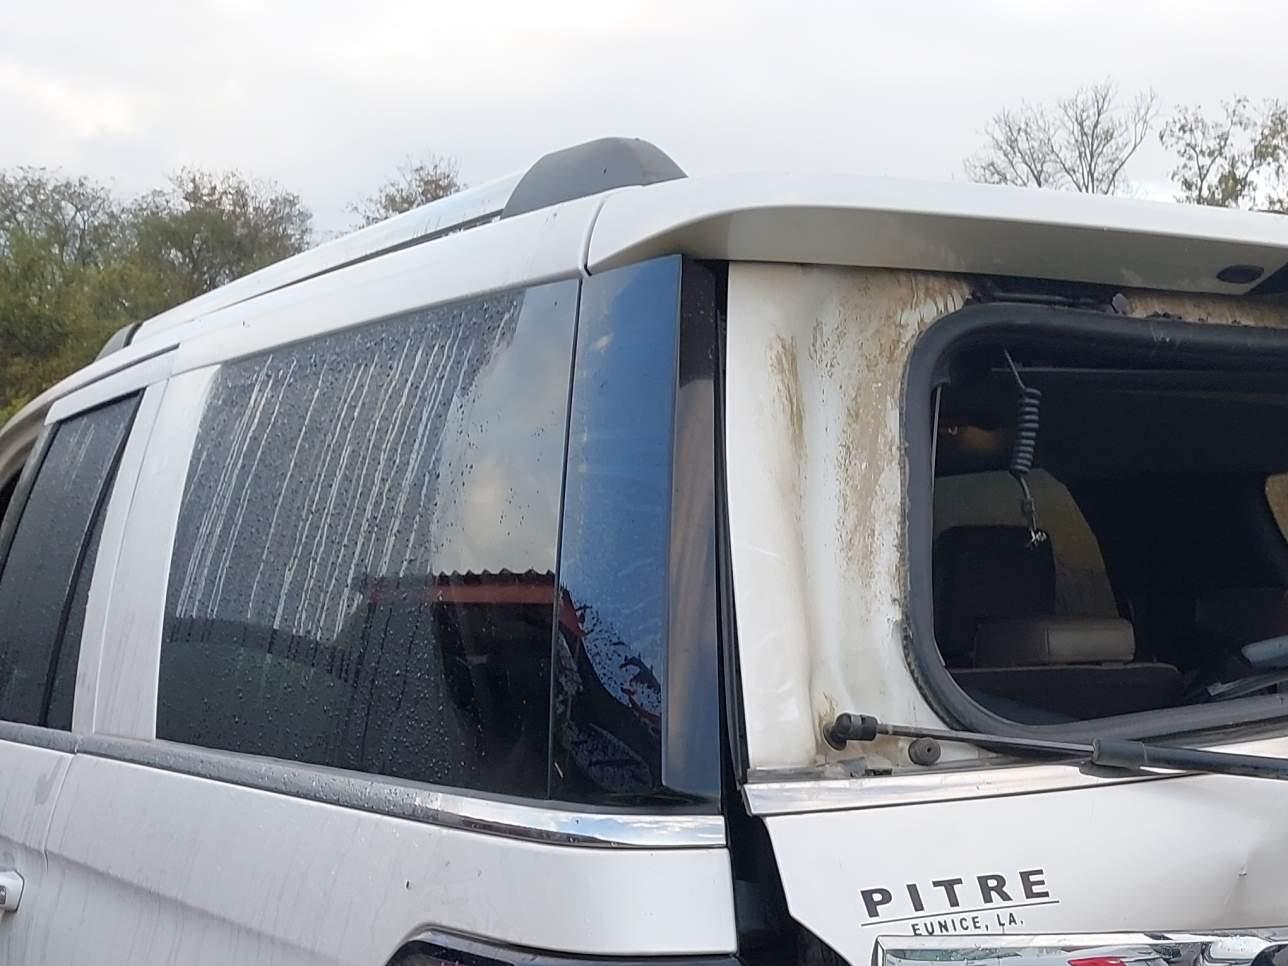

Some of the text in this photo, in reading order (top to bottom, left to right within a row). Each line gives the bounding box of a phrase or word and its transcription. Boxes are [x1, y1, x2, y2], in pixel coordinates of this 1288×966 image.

[860, 868, 1050, 918] PITRE
[911, 912, 1025, 937] EUNICE, LA.
